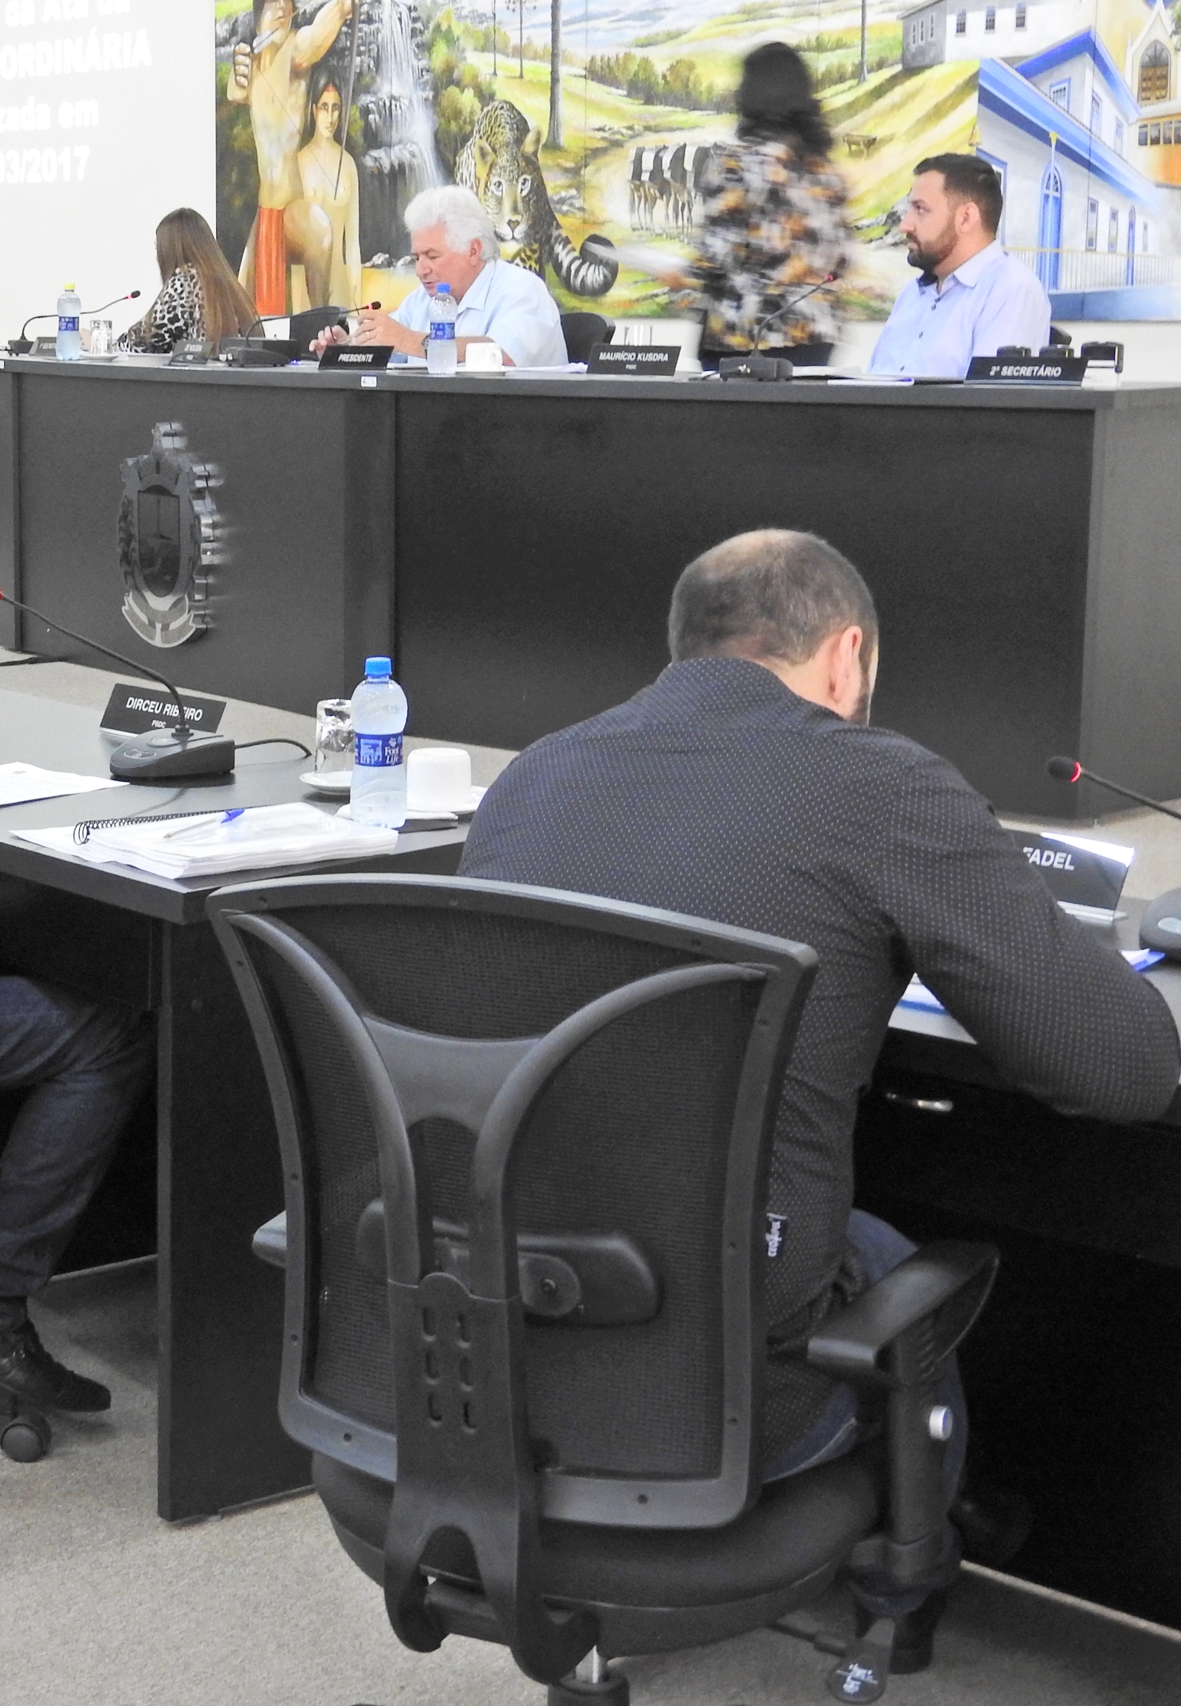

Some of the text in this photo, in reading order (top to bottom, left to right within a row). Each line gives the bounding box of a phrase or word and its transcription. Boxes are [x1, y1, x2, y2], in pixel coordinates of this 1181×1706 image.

[4, 0, 36, 28] da
[0, 26, 153, 81] ORDINÁRIA
[58, 98, 99, 129] em
[337, 353, 374, 363] PRESIDENTE
[599, 350, 637, 362] MAURÍCIO
[1001, 364, 1062, 378] SECRETÁRIO
[125, 697, 163, 714] DIRCEU
